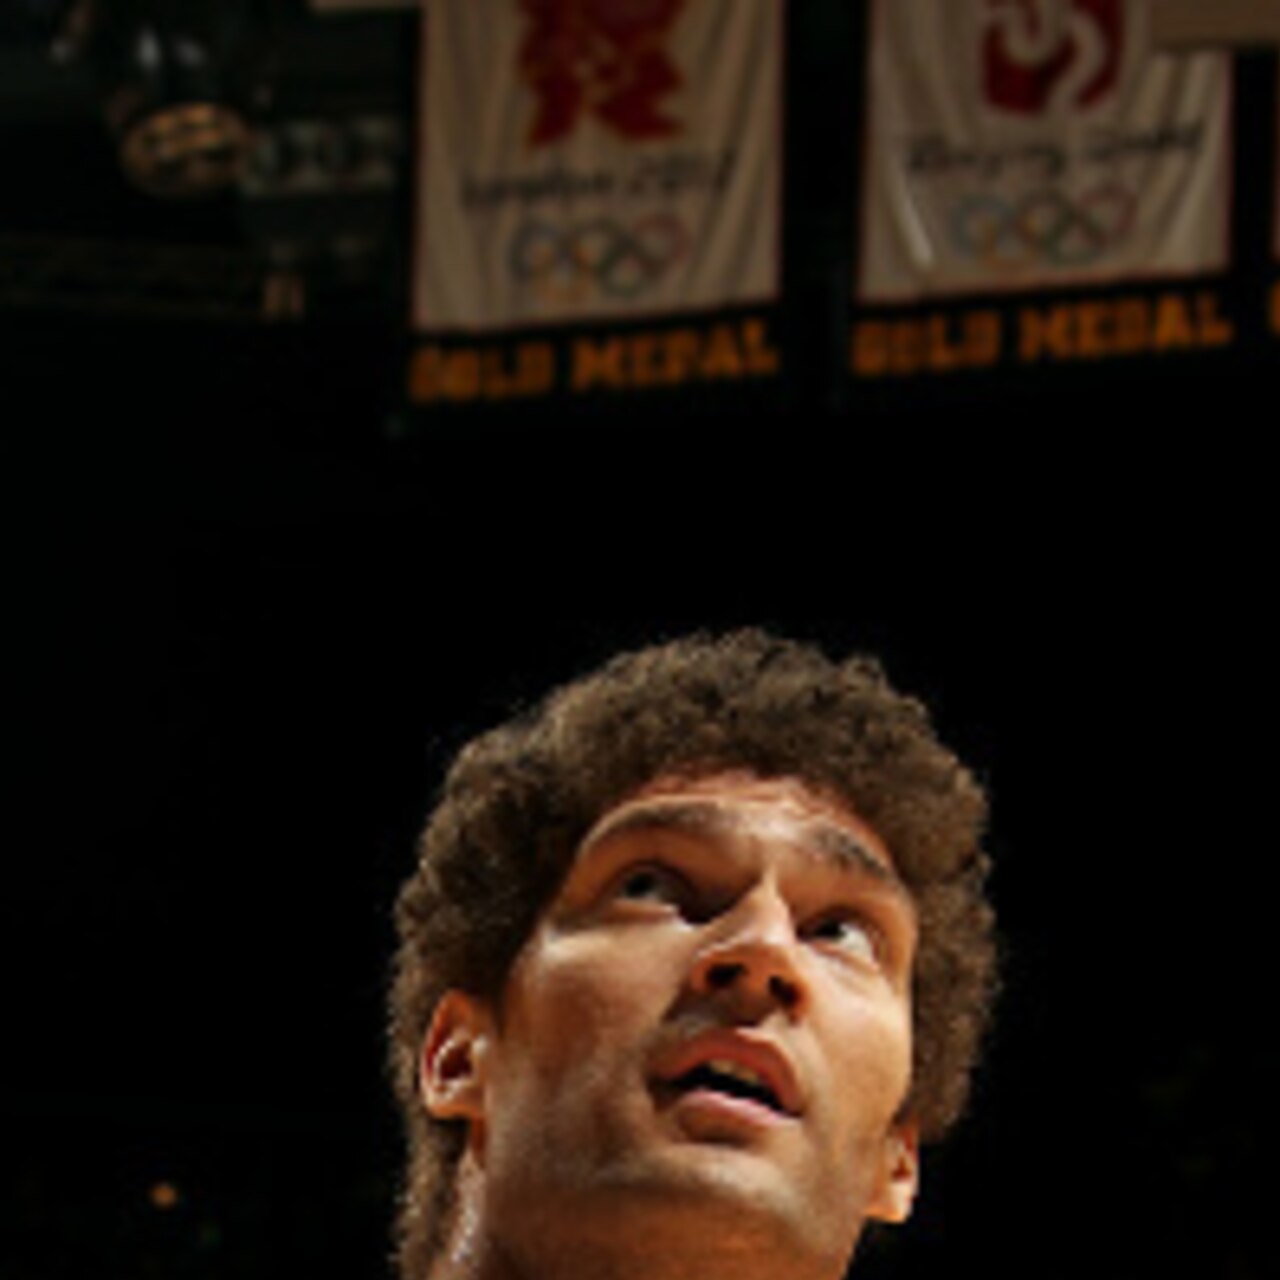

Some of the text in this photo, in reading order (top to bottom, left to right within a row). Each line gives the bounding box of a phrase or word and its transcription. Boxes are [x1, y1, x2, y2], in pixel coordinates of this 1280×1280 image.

[407, 315, 784, 404] GOLD MEDAL
[847, 287, 1234, 380] GOLD MEDAL
